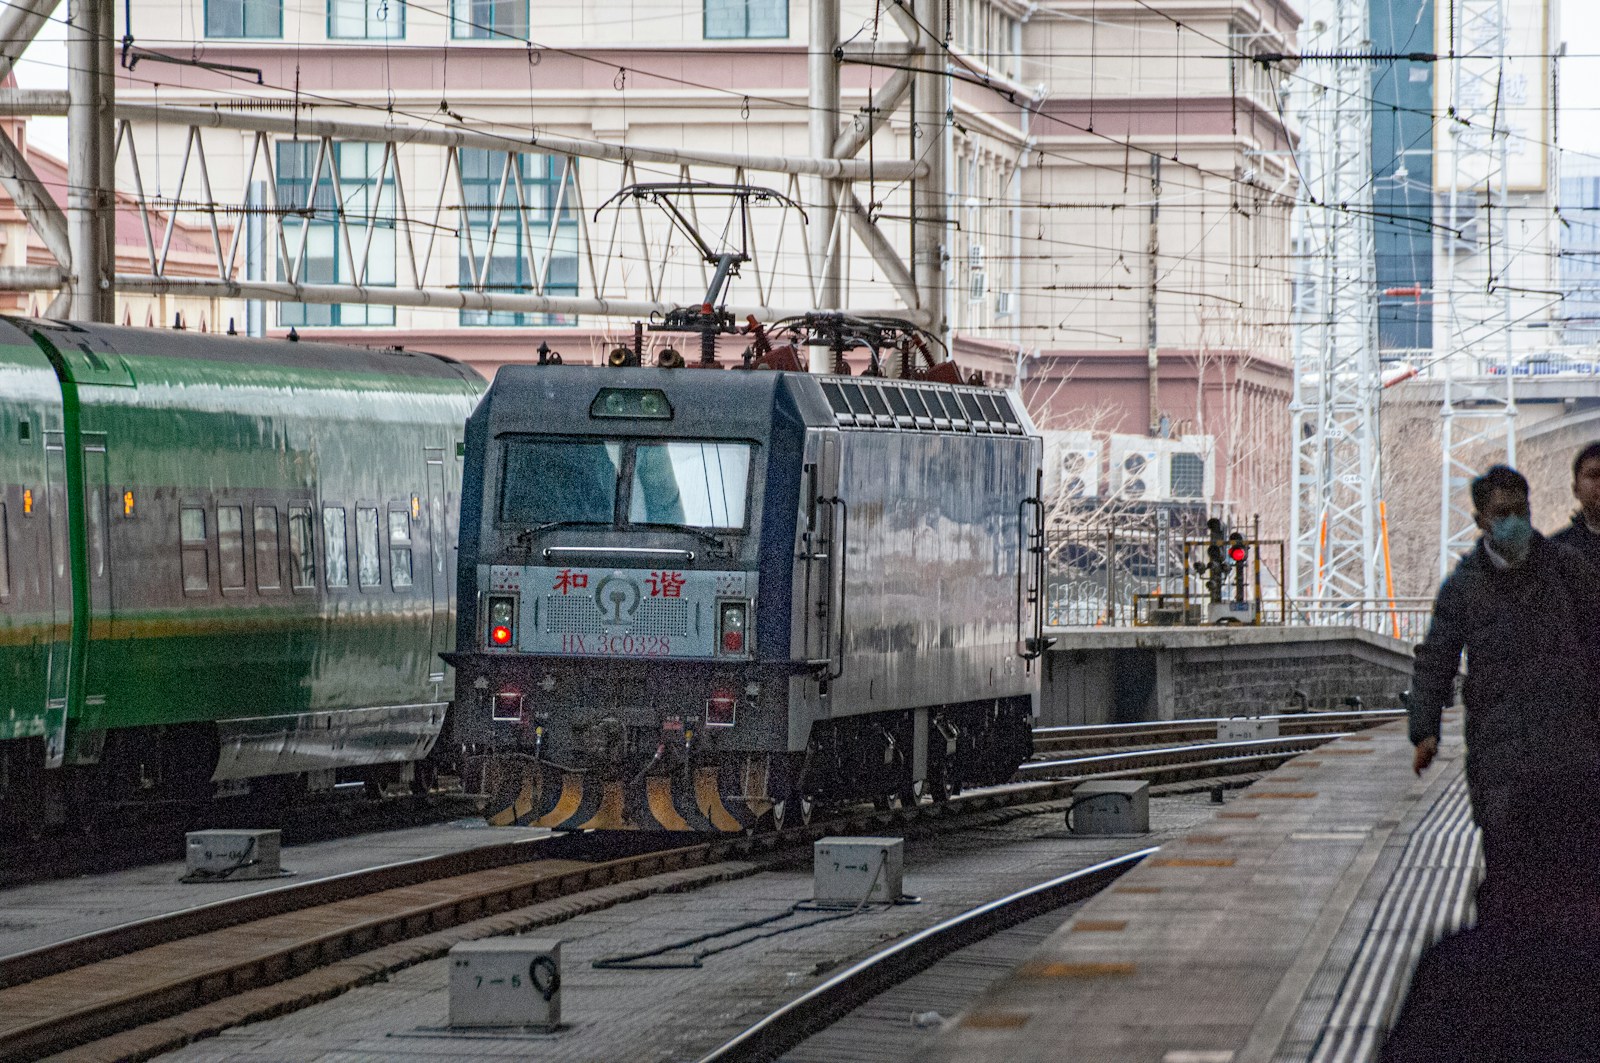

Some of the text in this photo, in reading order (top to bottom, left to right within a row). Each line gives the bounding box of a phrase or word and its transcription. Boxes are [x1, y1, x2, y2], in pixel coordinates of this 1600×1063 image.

[552, 568, 589, 595] 和
[645, 571, 686, 598] 谐
[833, 862, 869, 873] 7-4
